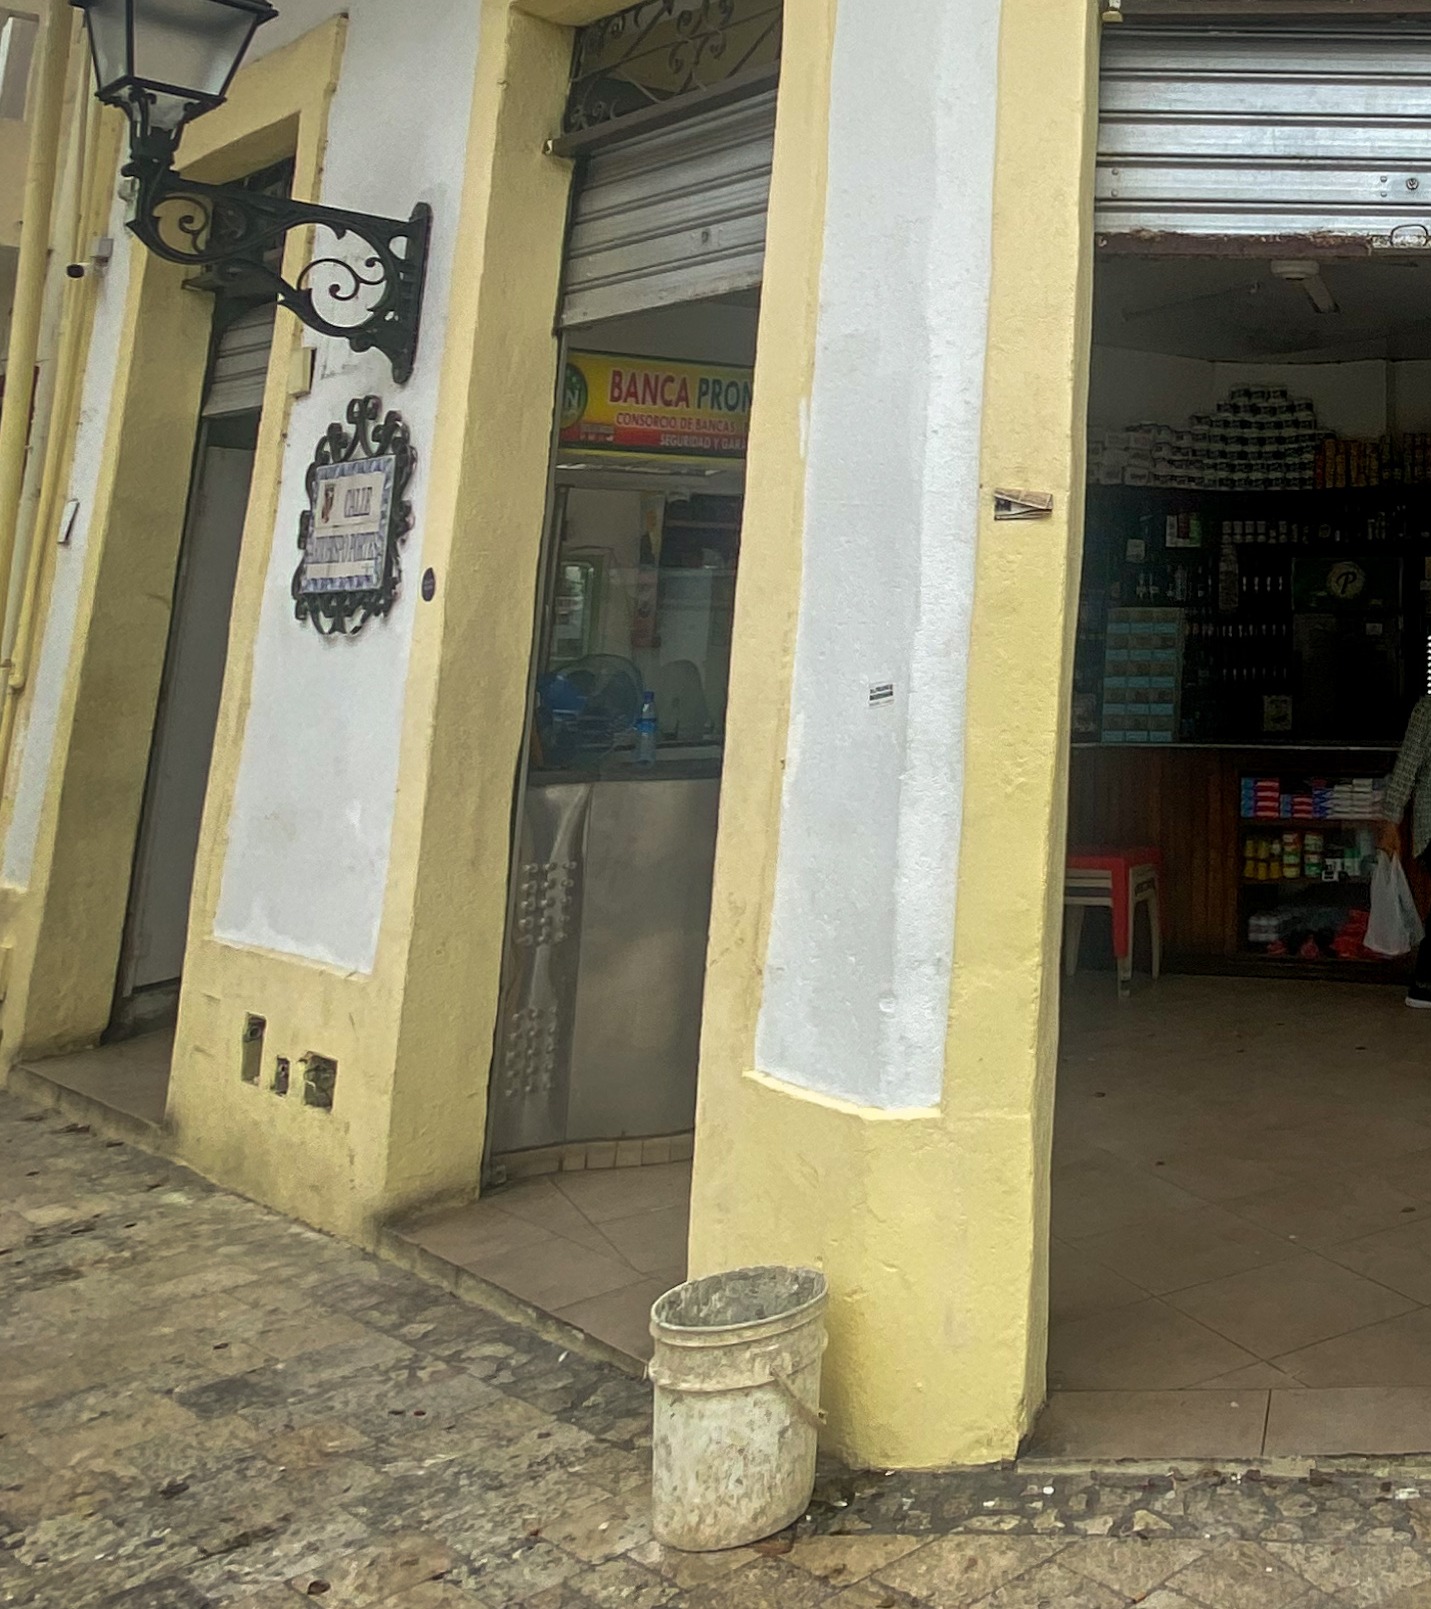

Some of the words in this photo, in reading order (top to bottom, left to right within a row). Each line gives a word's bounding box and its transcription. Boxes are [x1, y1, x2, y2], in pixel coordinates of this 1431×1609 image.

[609, 370, 690, 408] BANCA
[616, 413, 679, 429] CONSORCIO
[680, 417, 693, 430] DE
[695, 419, 735, 433] BANCAS
[660, 433, 711, 449] SEGURIDAD
[713, 437, 720, 450] Y
